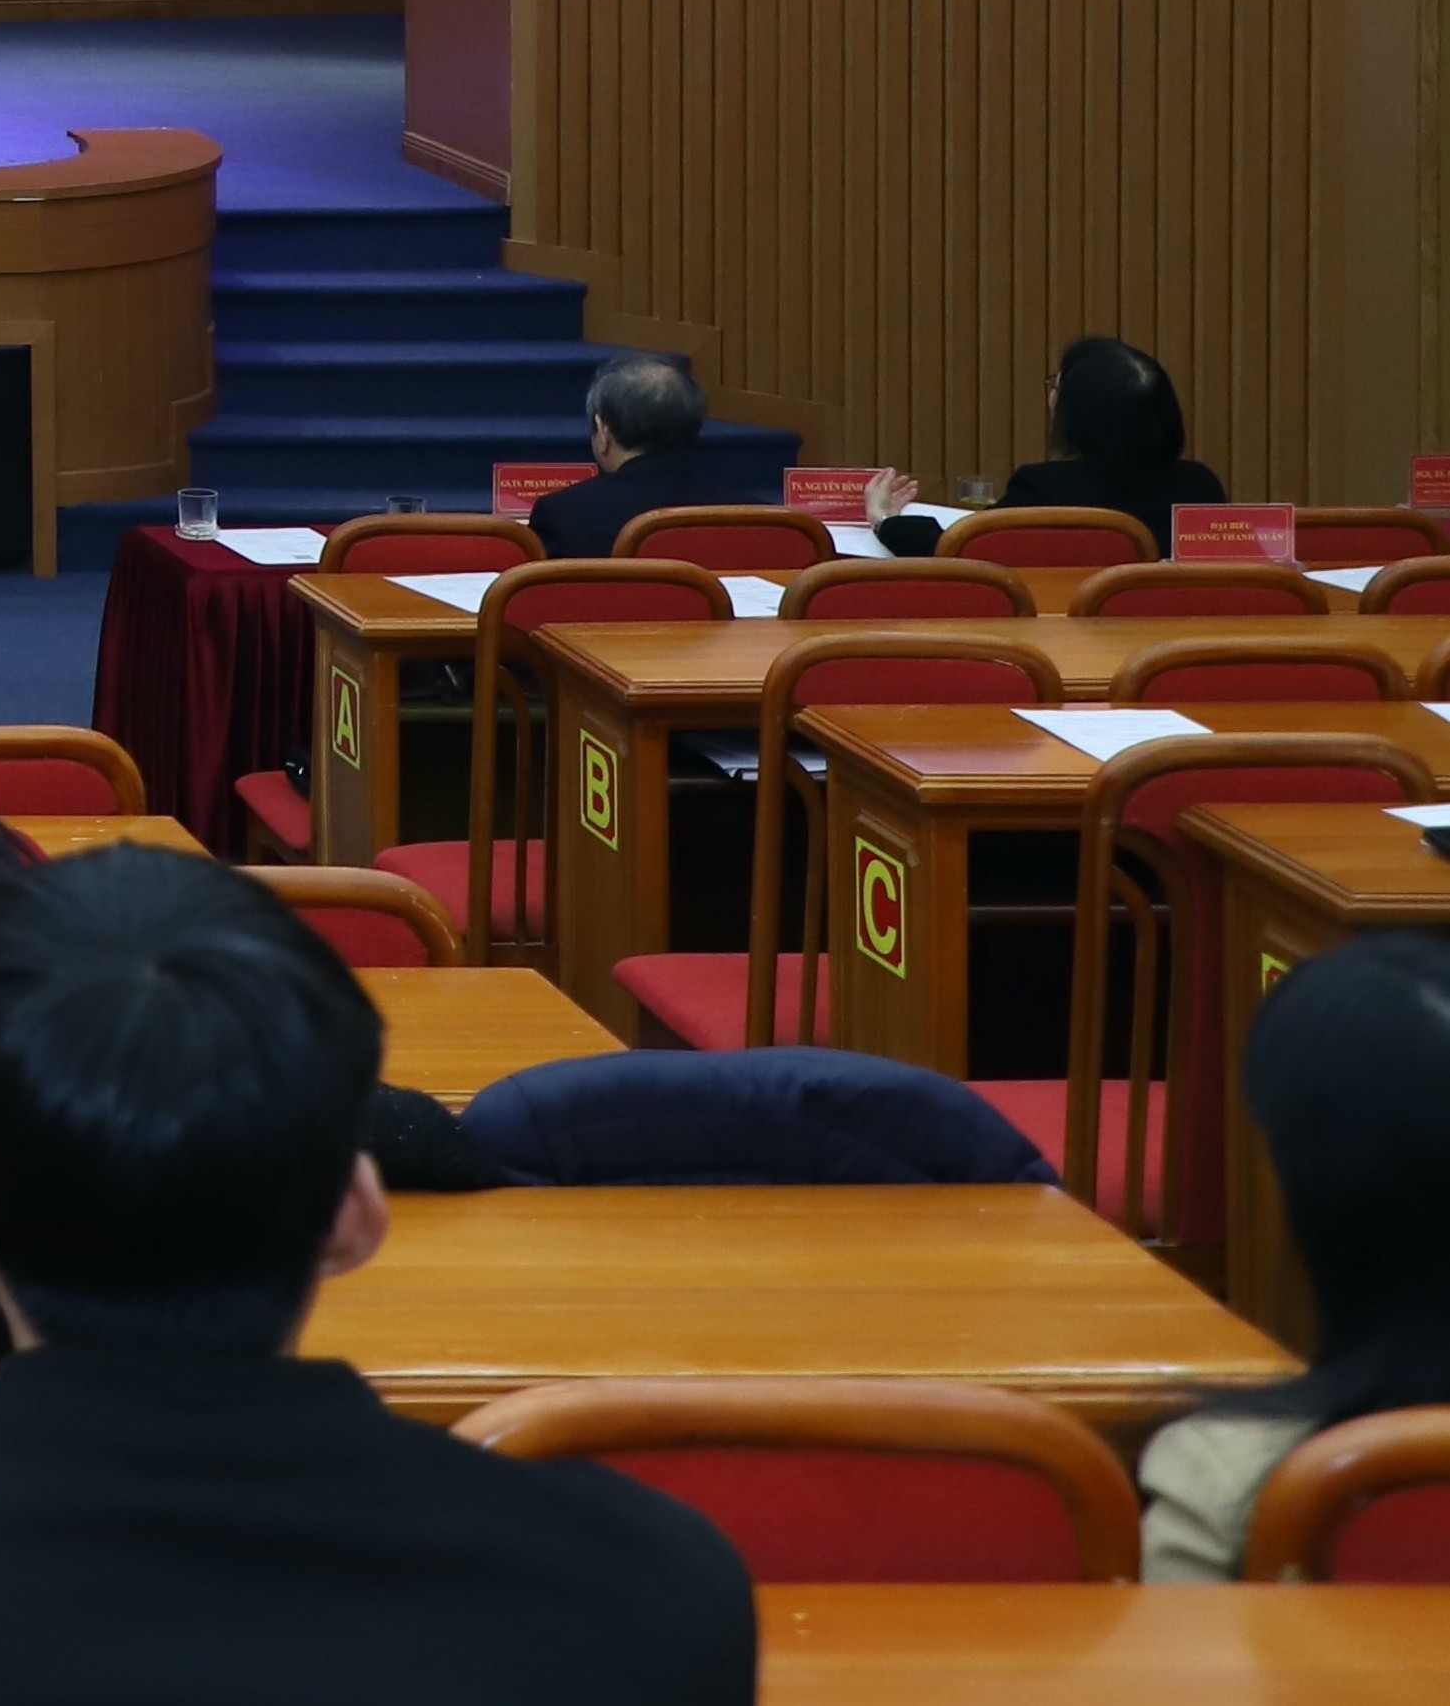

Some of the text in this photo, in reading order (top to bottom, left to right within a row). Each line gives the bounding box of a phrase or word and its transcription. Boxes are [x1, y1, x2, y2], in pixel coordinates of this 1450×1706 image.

[336, 683, 356, 756] A
[586, 744, 610, 828] B
[863, 860, 896, 954] C
